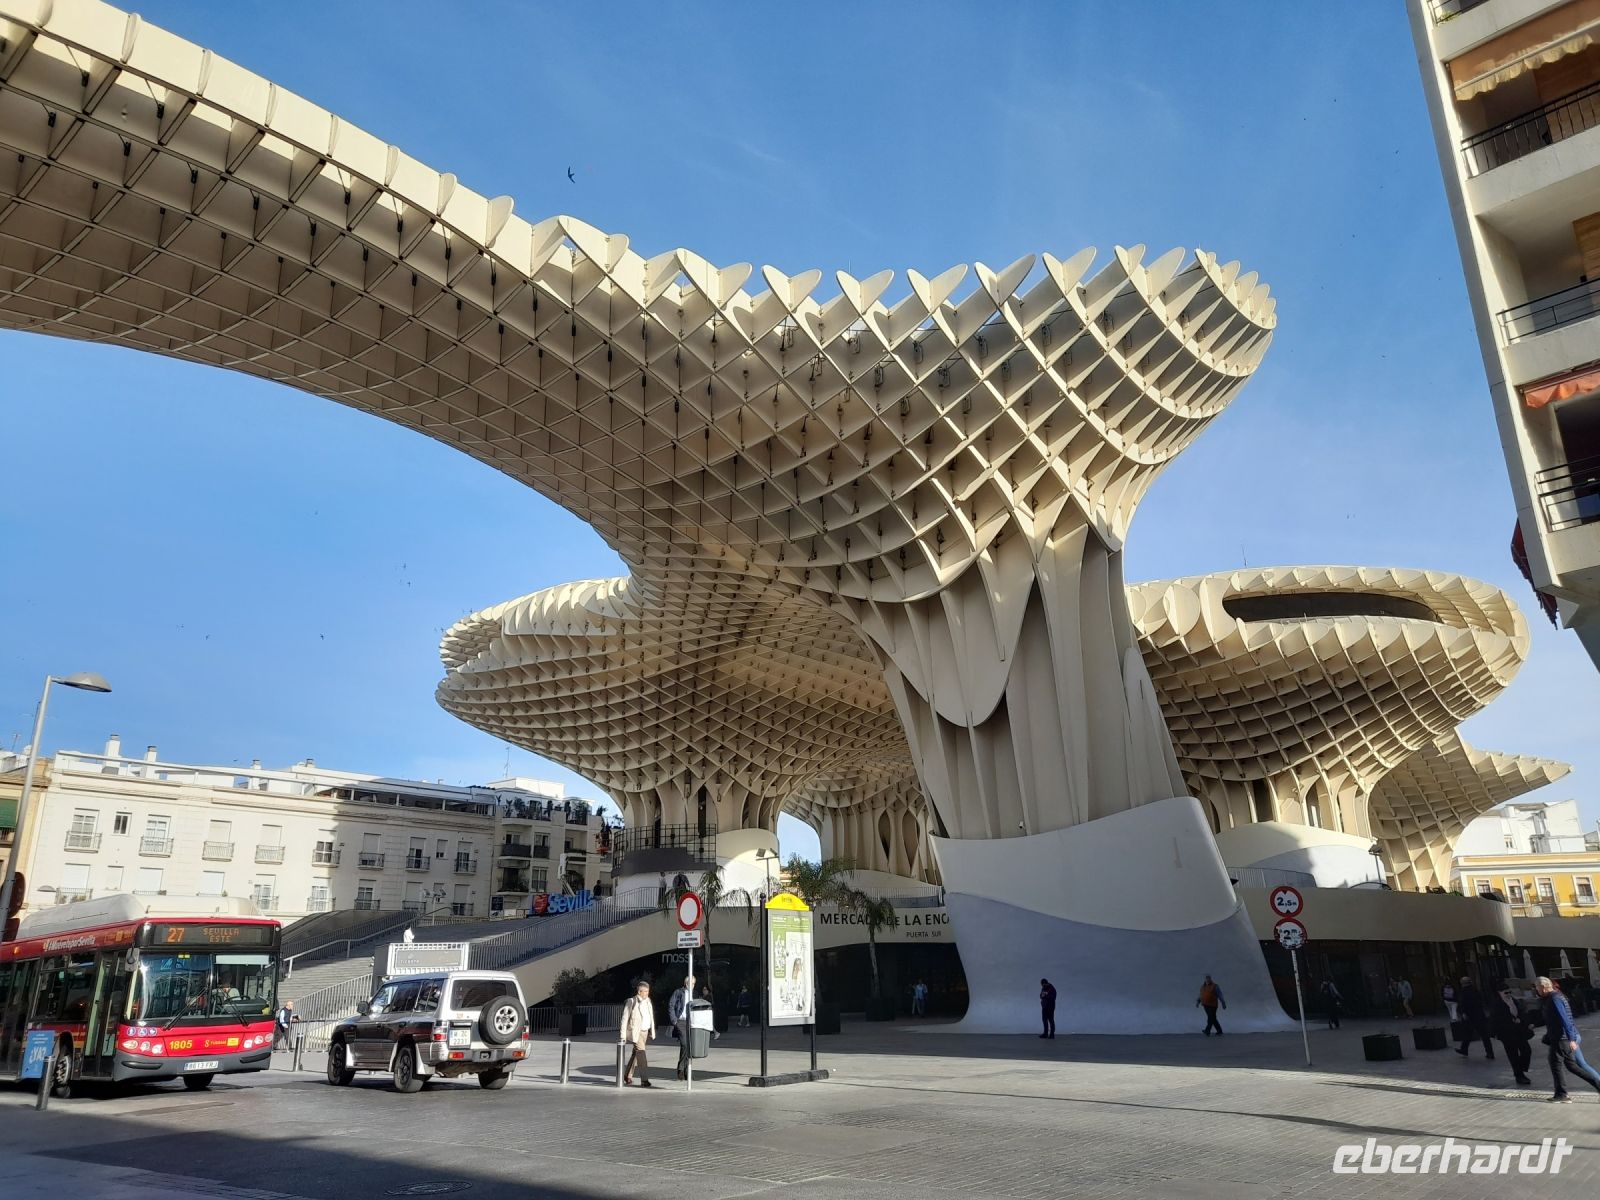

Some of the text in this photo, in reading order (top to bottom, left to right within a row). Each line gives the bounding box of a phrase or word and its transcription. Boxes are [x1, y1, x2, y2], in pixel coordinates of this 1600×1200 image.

[820, 913, 884, 925] MERCAD
[904, 914, 921, 926] LA
[167, 927, 185, 943] 27
[202, 927, 240, 937] SEVILLA
[209, 935, 231, 943] ESTE
[169, 1040, 192, 1050] 1805
